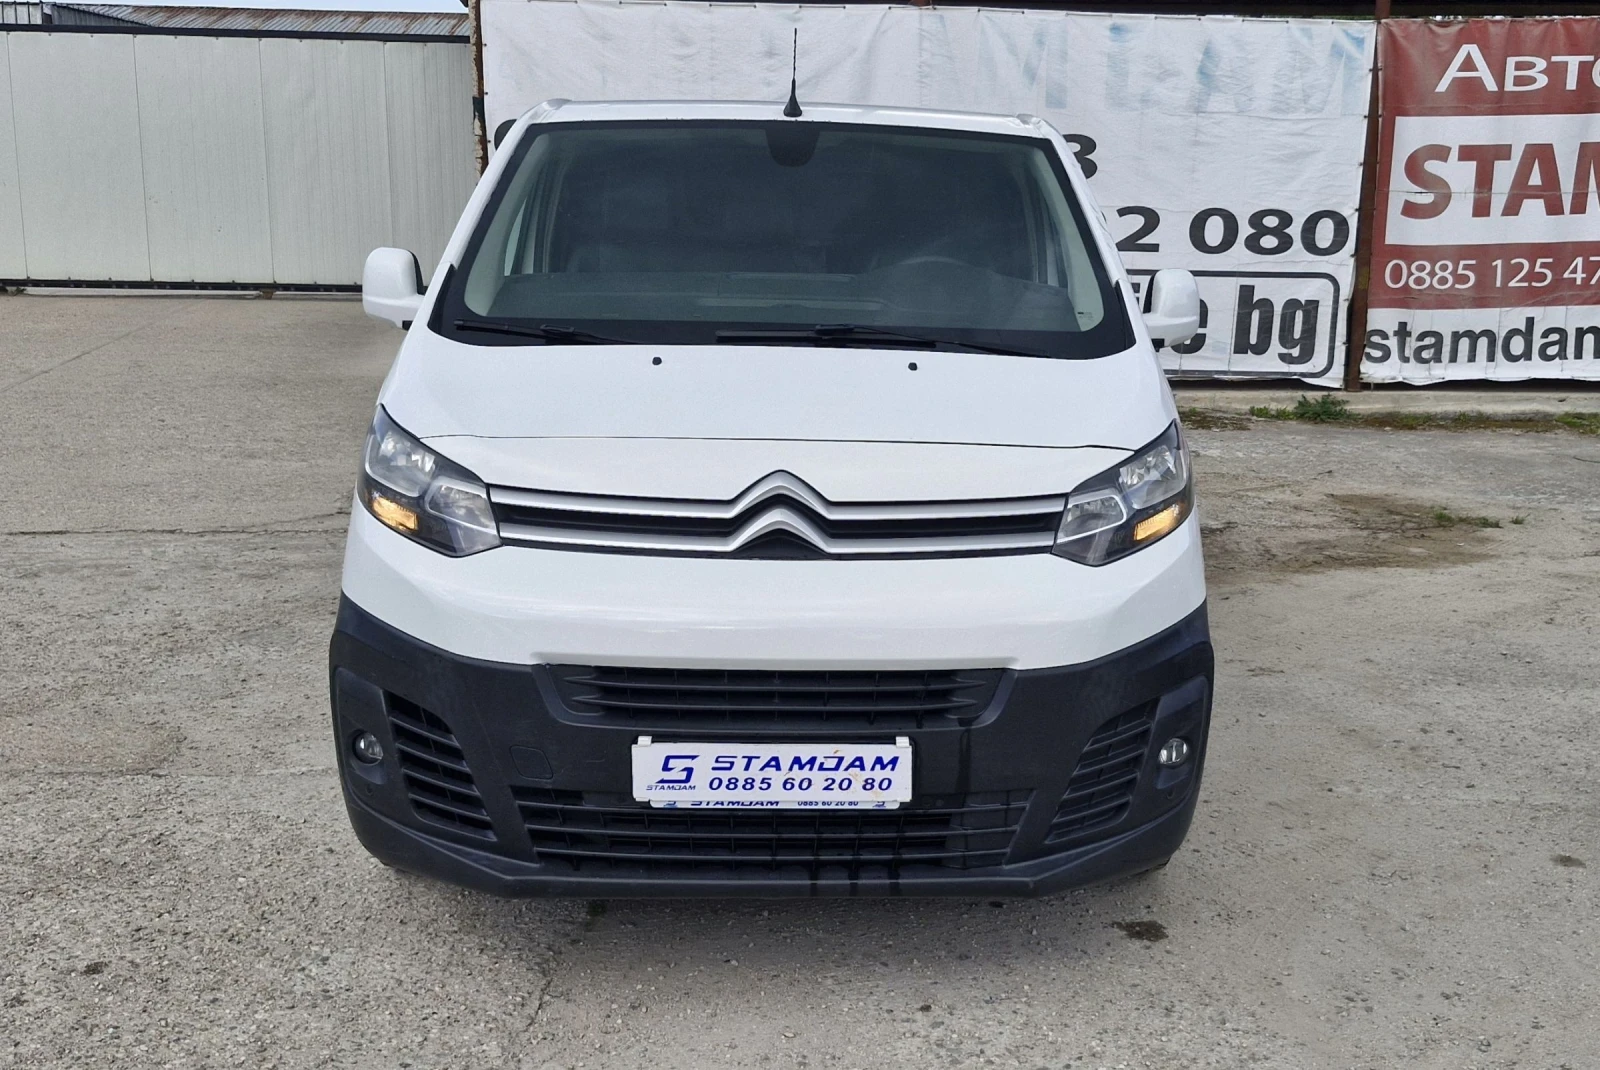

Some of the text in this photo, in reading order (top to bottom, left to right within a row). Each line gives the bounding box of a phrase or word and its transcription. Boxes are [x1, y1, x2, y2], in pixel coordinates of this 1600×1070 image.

[1434, 43, 1600, 93] АВТ
[1188, 207, 1350, 257] 080
[1384, 259, 1476, 290] 0885
[1491, 257, 1553, 288] 125
[708, 777, 893, 791] 0885 60 20 80
